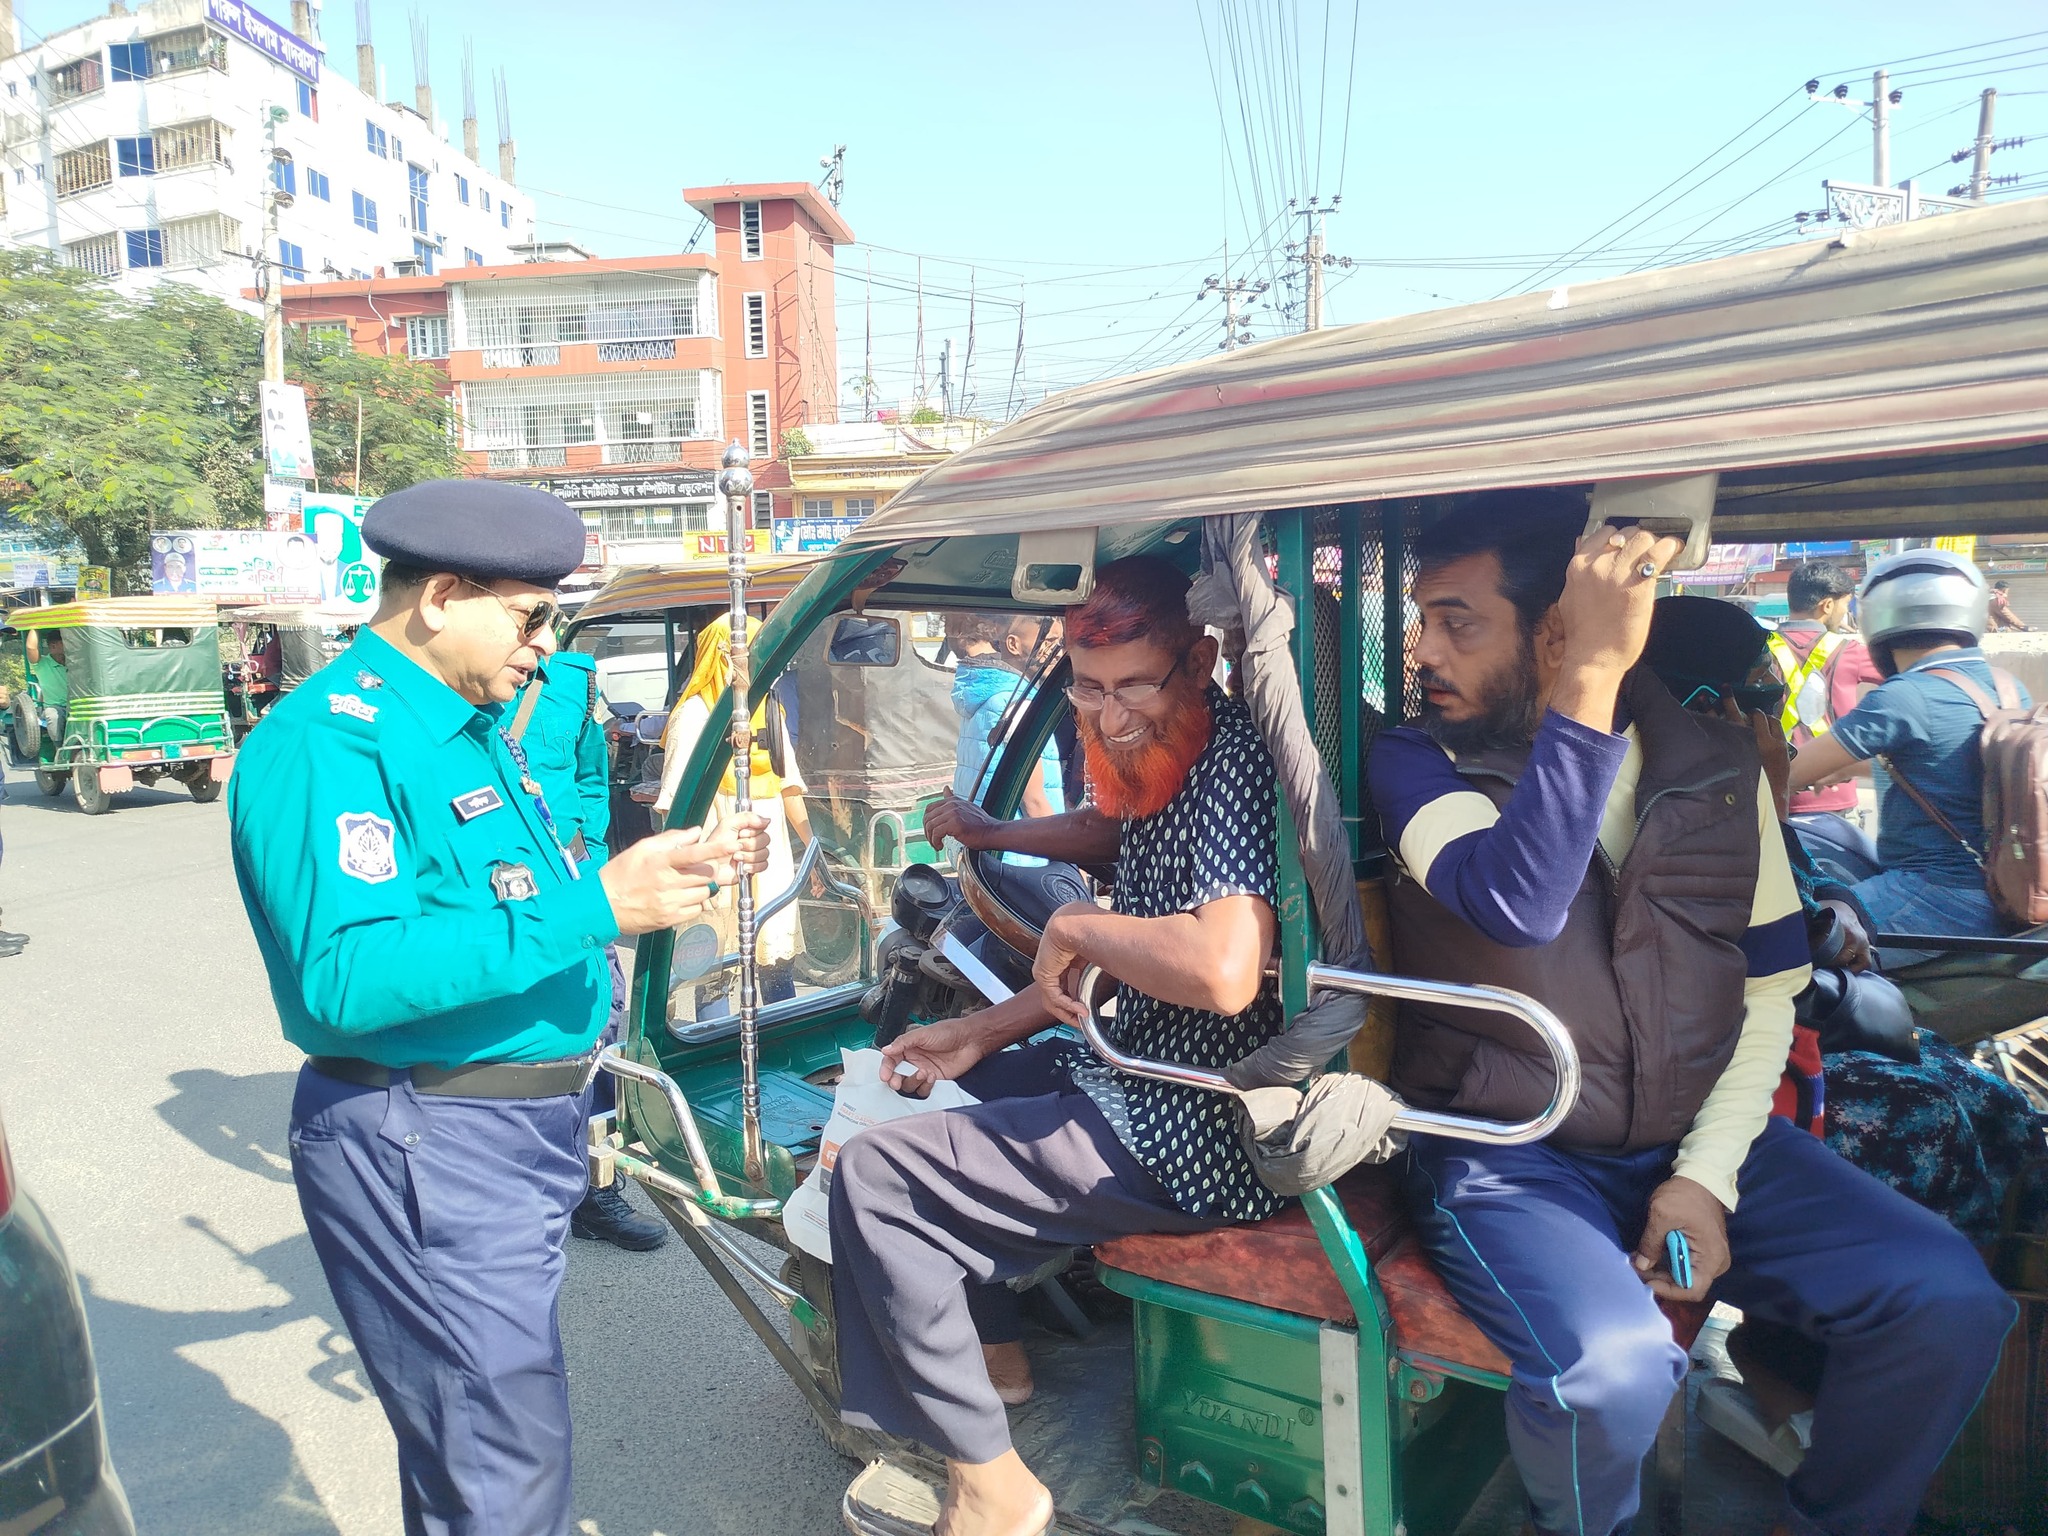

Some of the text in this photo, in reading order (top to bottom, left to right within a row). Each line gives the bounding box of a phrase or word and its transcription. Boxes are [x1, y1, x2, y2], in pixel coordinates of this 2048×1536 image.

[242, 3, 278, 54] ইসলাম
[279, 34, 317, 79] মাদরাসা
[620, 485, 635, 497] অব
[677, 480, 715, 497] এডুকেশন
[328, 693, 379, 723] পুলিশ
[1184, 1390, 1296, 1446] YUANDI
